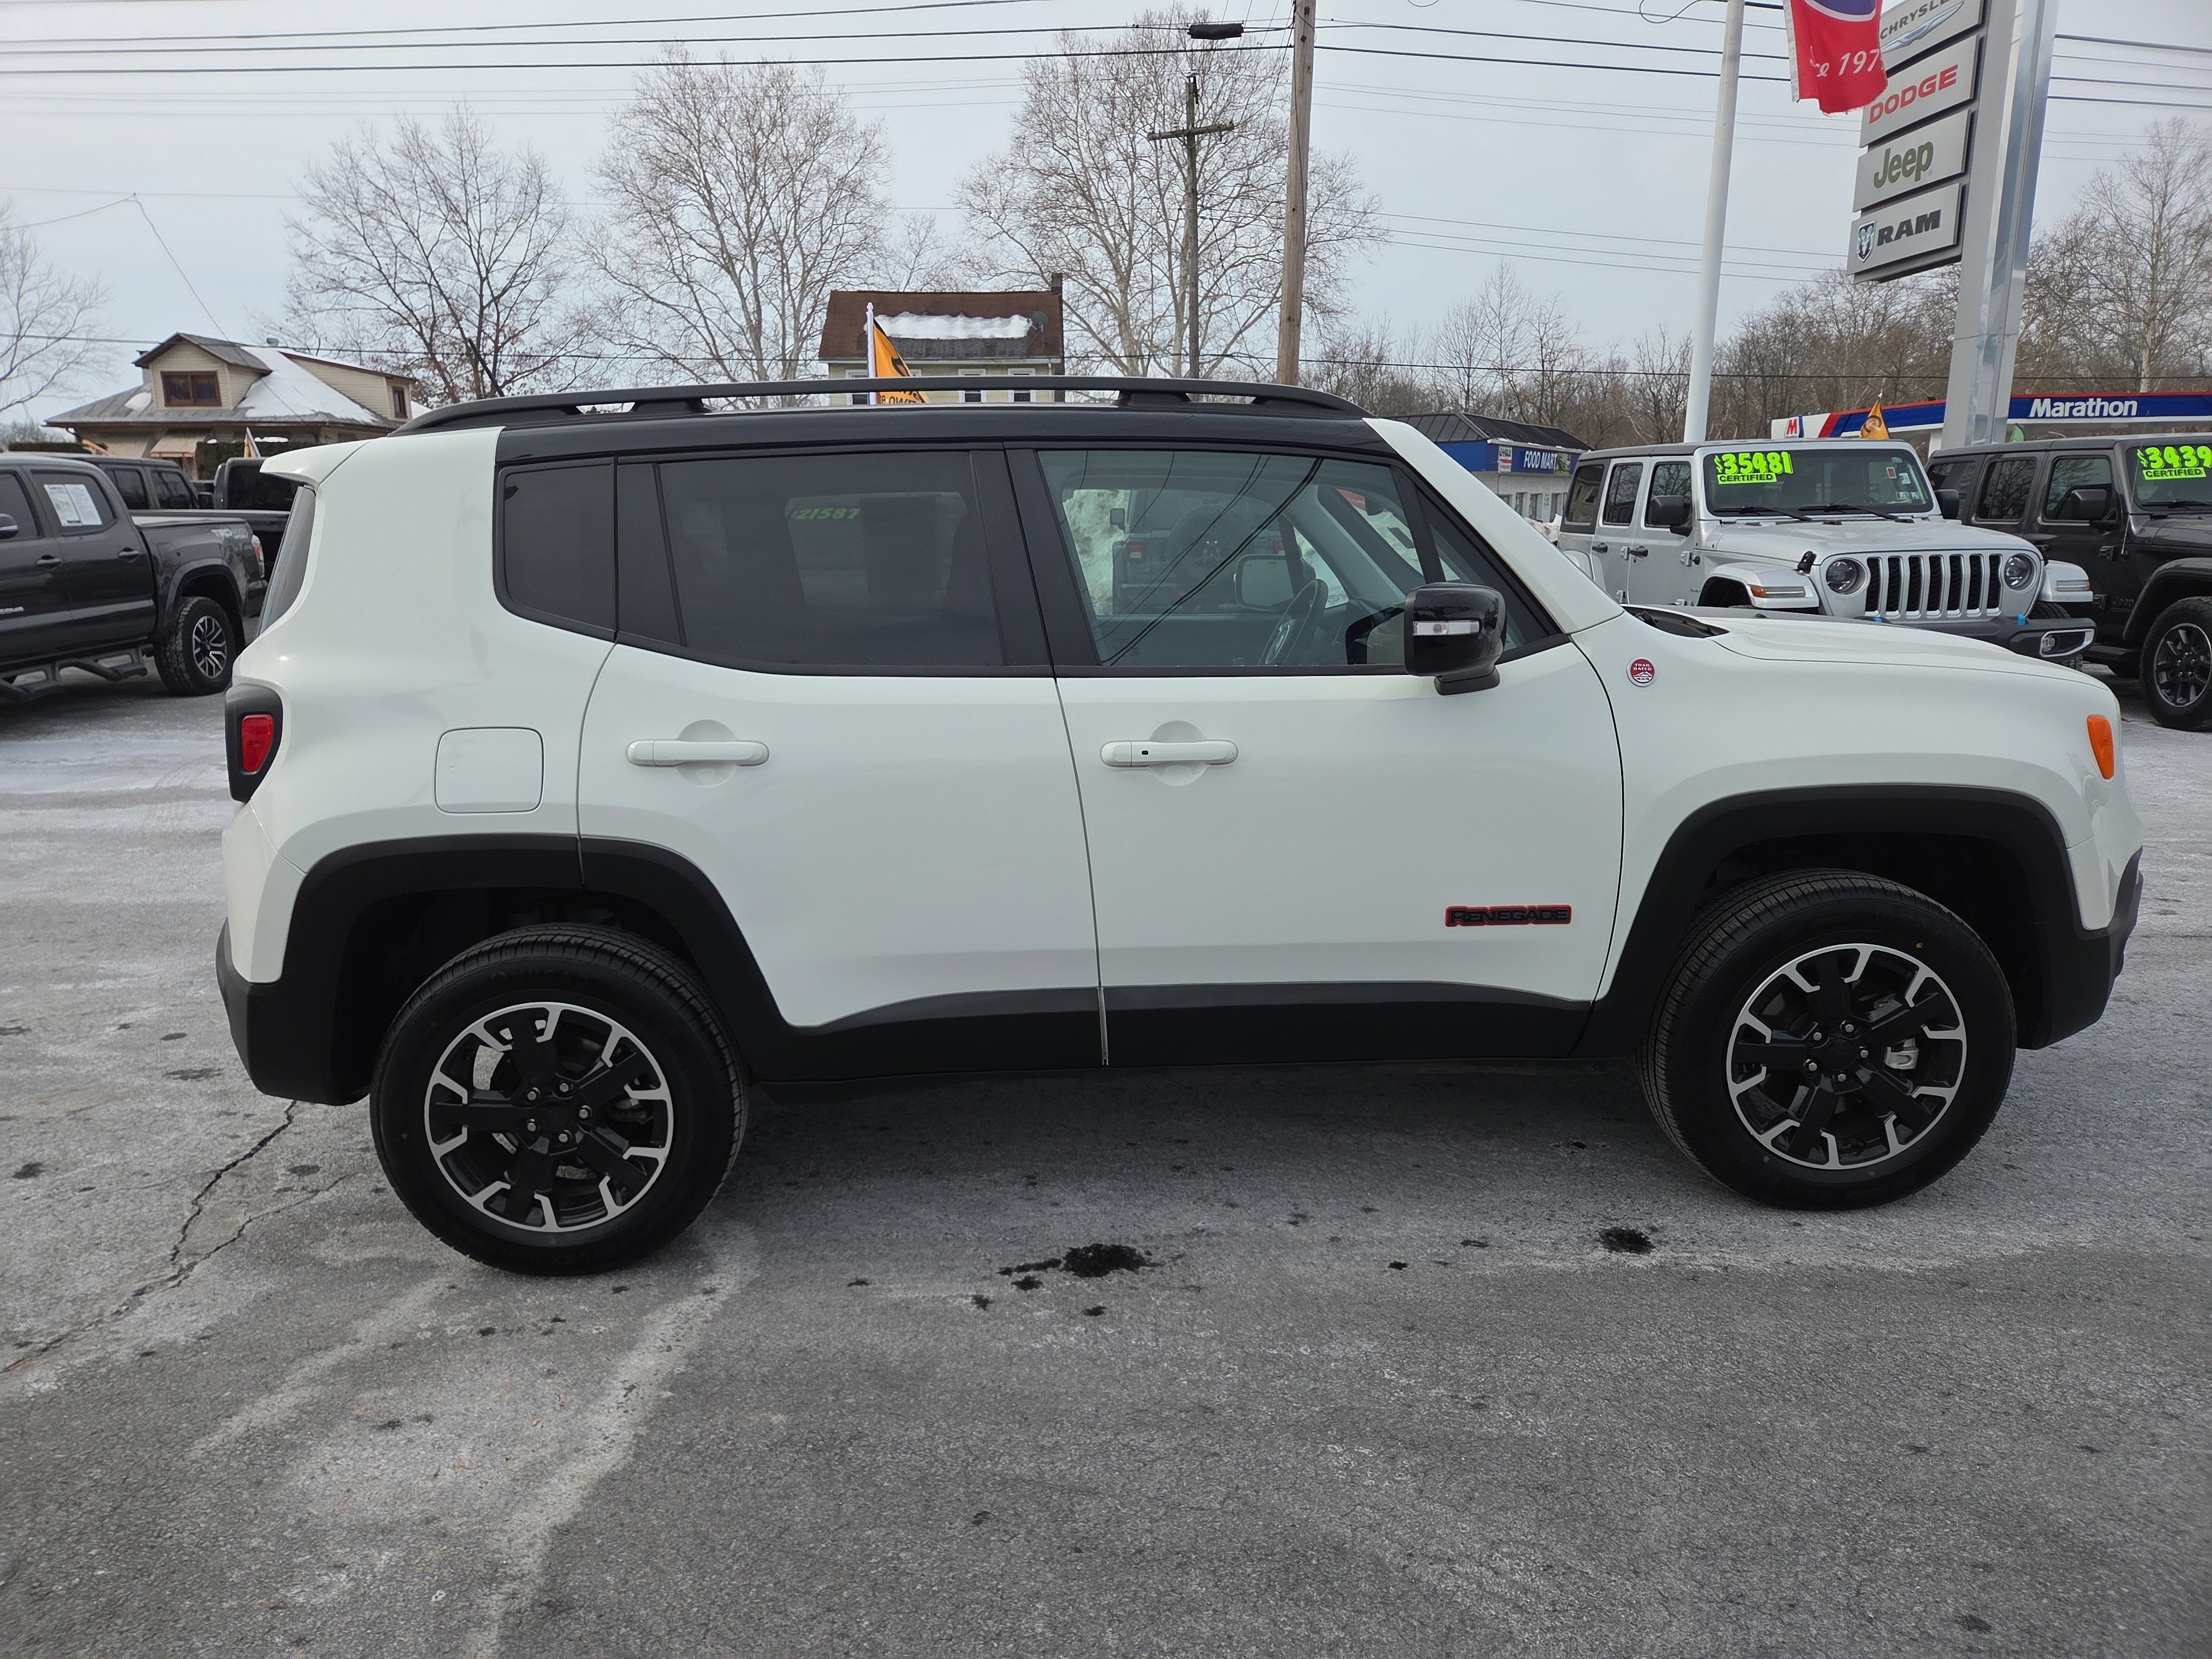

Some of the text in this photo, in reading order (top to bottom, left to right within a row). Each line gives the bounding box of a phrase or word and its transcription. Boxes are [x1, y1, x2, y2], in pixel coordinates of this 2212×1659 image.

[1880, 0, 1950, 40] CHRYSL
[1838, 48, 1884, 75] 197
[1869, 64, 1958, 124] DODGE
[1873, 141, 1933, 188] Jeep
[1876, 209, 1941, 247] RAM
[2029, 397, 2138, 417] Marathon
[1786, 419, 1797, 435] M
[1523, 451, 1540, 468] FOOD
[1540, 452, 1558, 469] MART
[1714, 451, 1793, 474] $35481
[2137, 446, 2212, 468] $3439
[1719, 473, 1774, 482] CERTIFIED
[2145, 468, 2202, 478] CERTIFIED
[1446, 906, 1571, 925] RENEGADE
